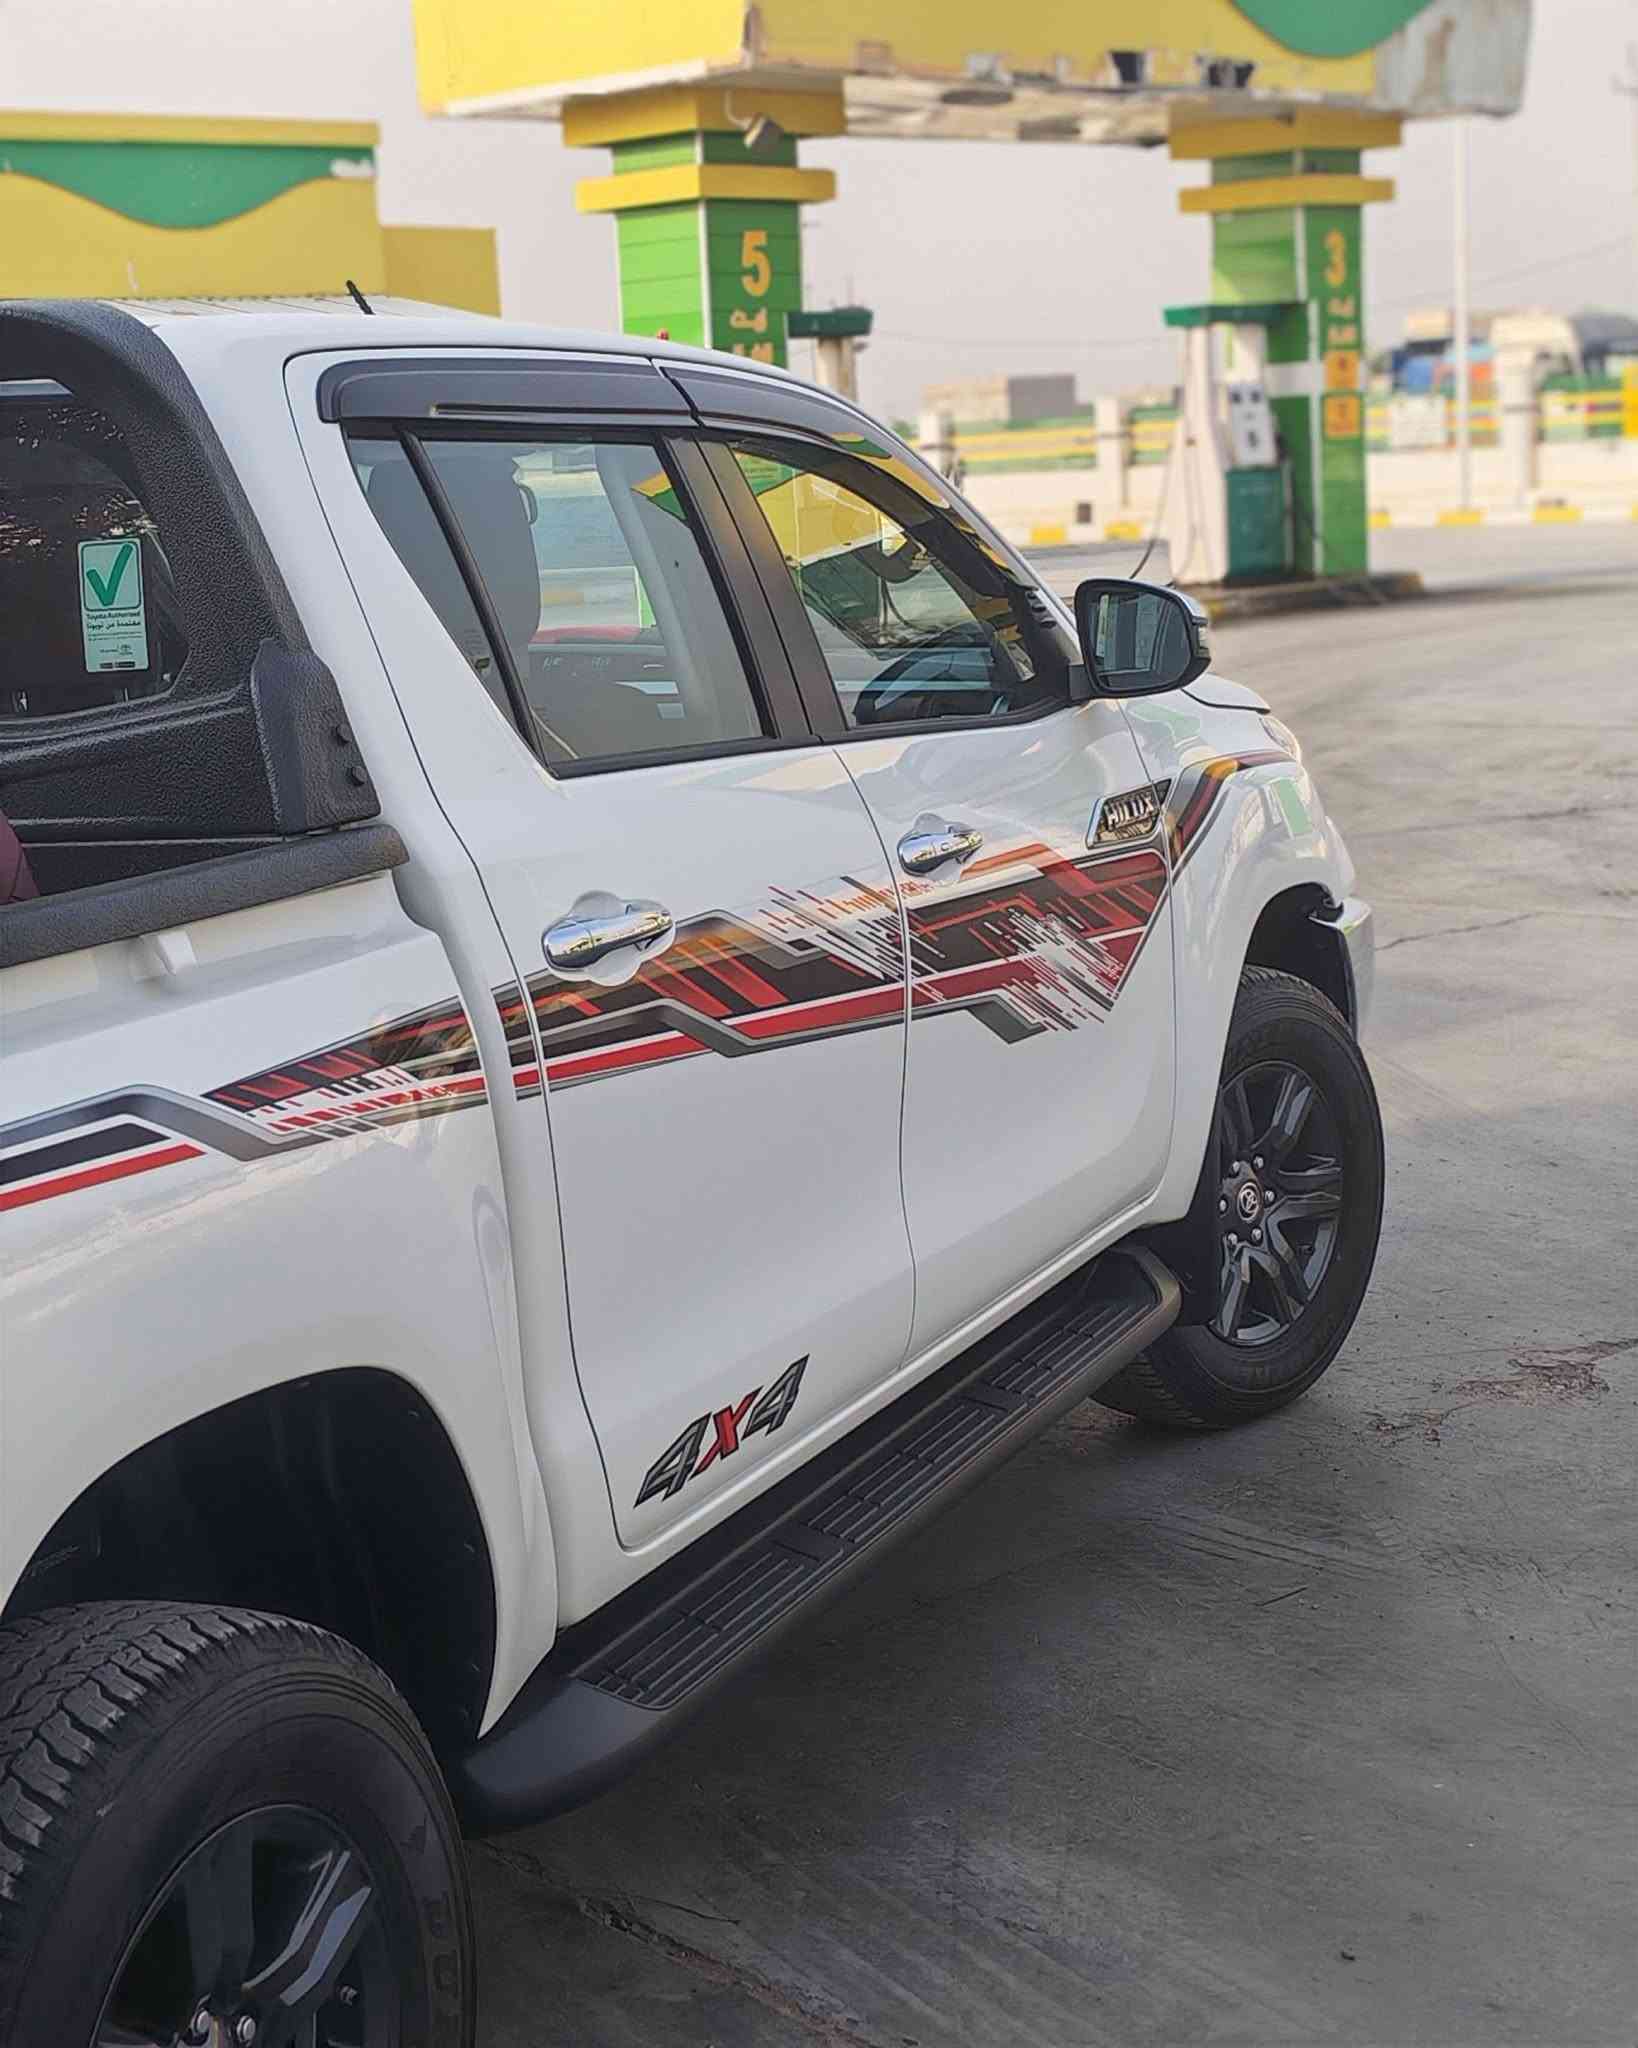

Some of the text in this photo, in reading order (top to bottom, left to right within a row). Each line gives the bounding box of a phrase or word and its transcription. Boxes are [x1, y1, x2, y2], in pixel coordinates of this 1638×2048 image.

[742, 229, 770, 297] 5
[1325, 229, 1347, 287] 3
[1103, 791, 1155, 831] HILUX
